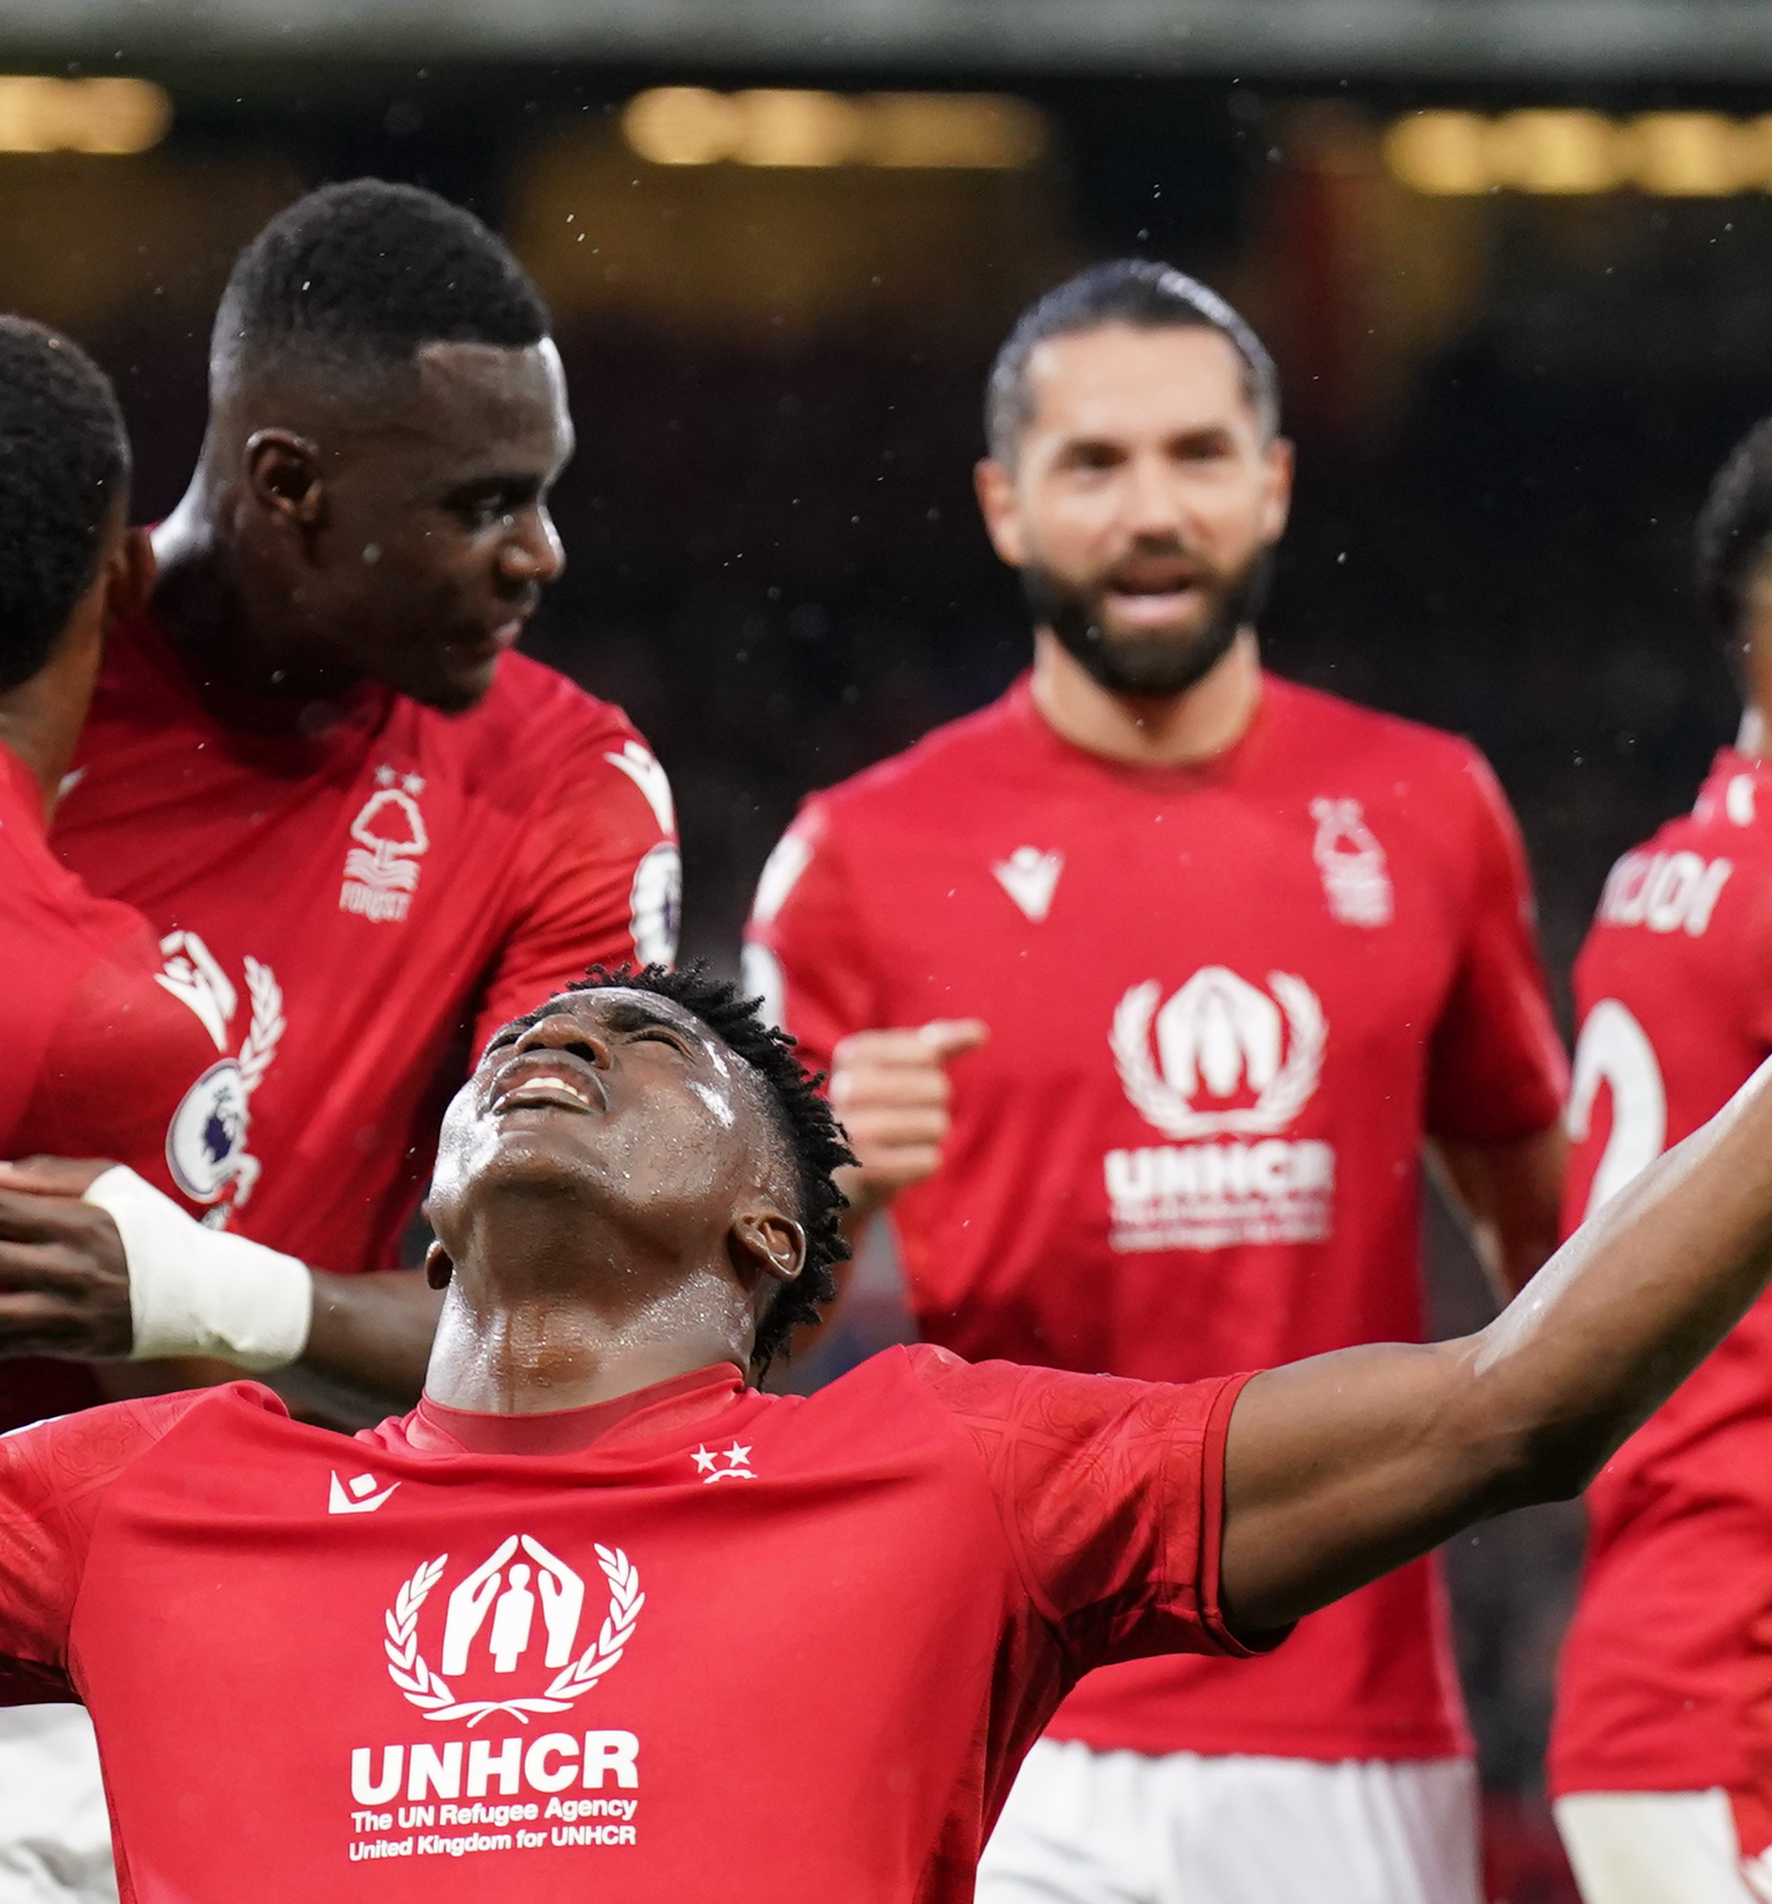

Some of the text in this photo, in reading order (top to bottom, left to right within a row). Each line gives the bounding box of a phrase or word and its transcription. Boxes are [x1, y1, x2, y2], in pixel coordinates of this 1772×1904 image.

[351, 1730, 639, 1805] UNHCR
[351, 1797, 638, 1833] The UN Refugee Agency
[349, 1826, 637, 1861] United Kingdom for UNHCR
